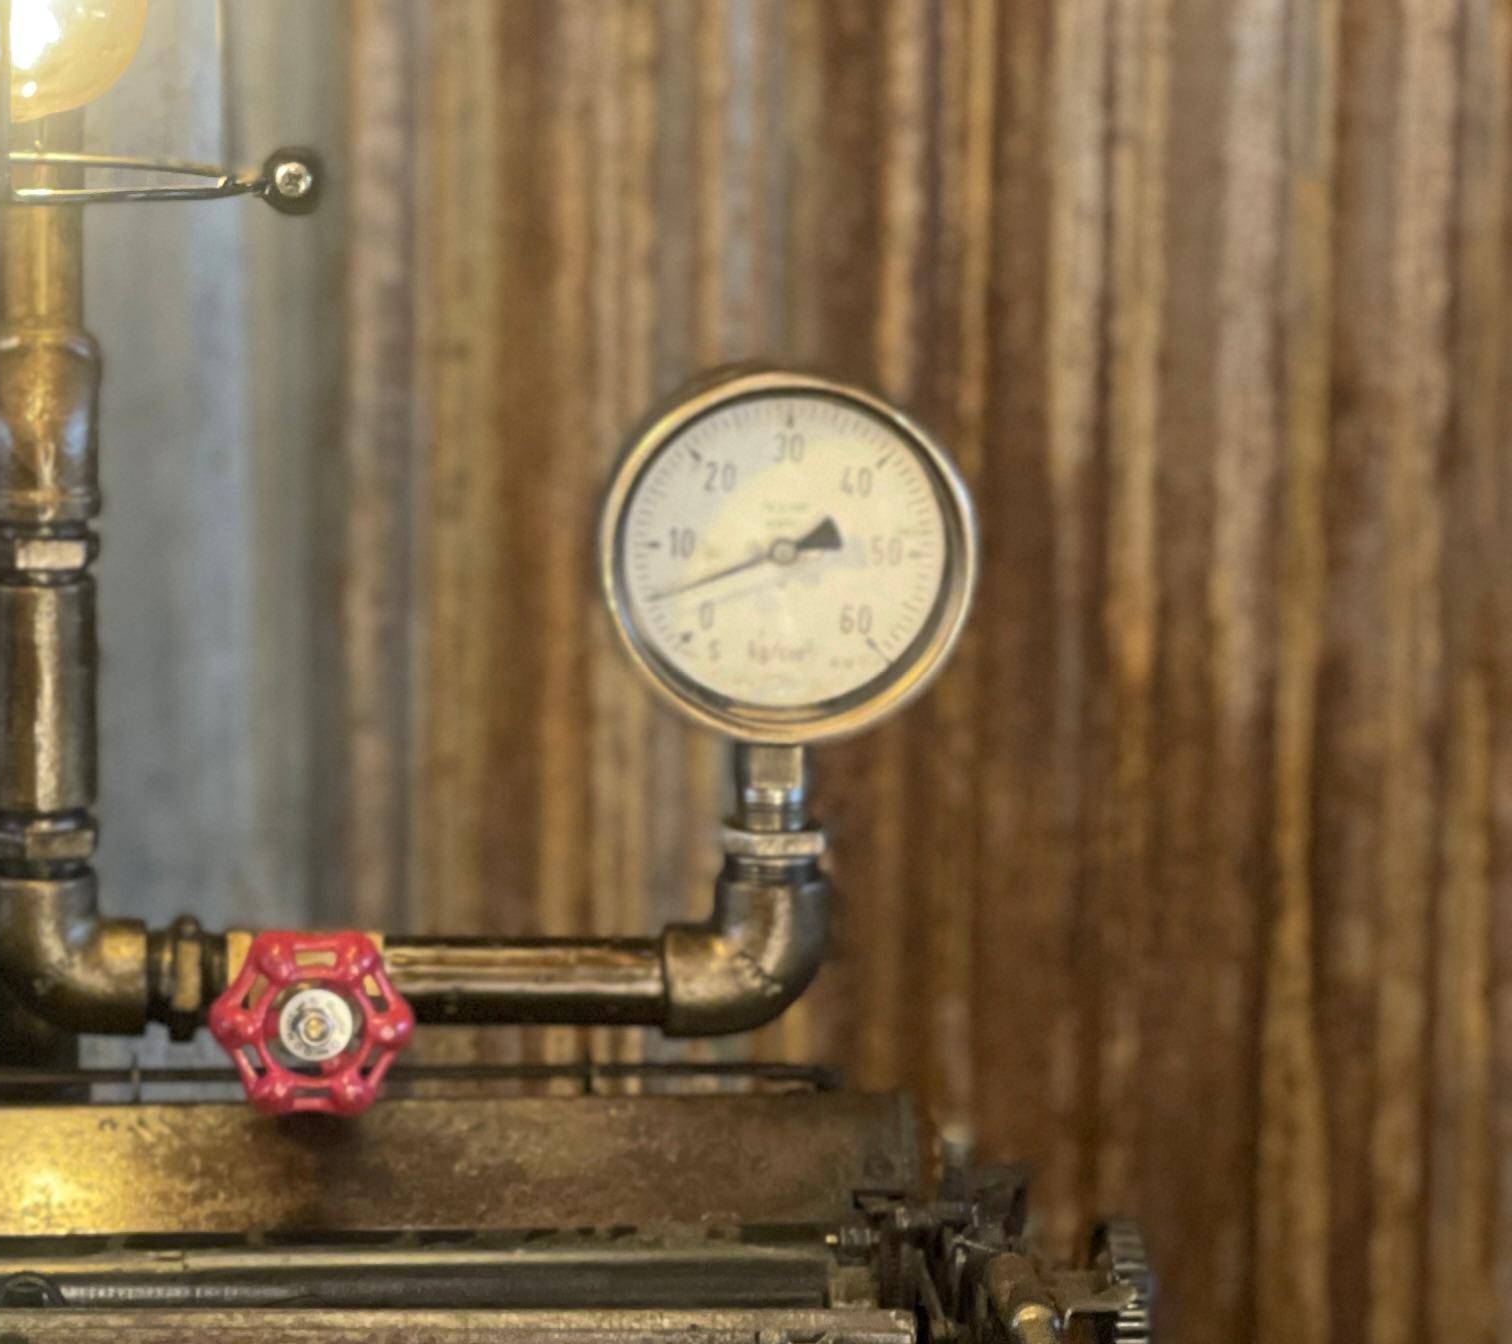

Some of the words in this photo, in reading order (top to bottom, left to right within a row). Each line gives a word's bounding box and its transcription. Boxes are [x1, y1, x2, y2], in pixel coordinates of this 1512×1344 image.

[772, 432, 805, 463] 30
[703, 462, 738, 493] 20
[840, 467, 874, 498] 40
[669, 527, 696, 559] 10
[870, 536, 903, 567] 50
[698, 601, 716, 630] 0
[839, 604, 874, 635] 60
